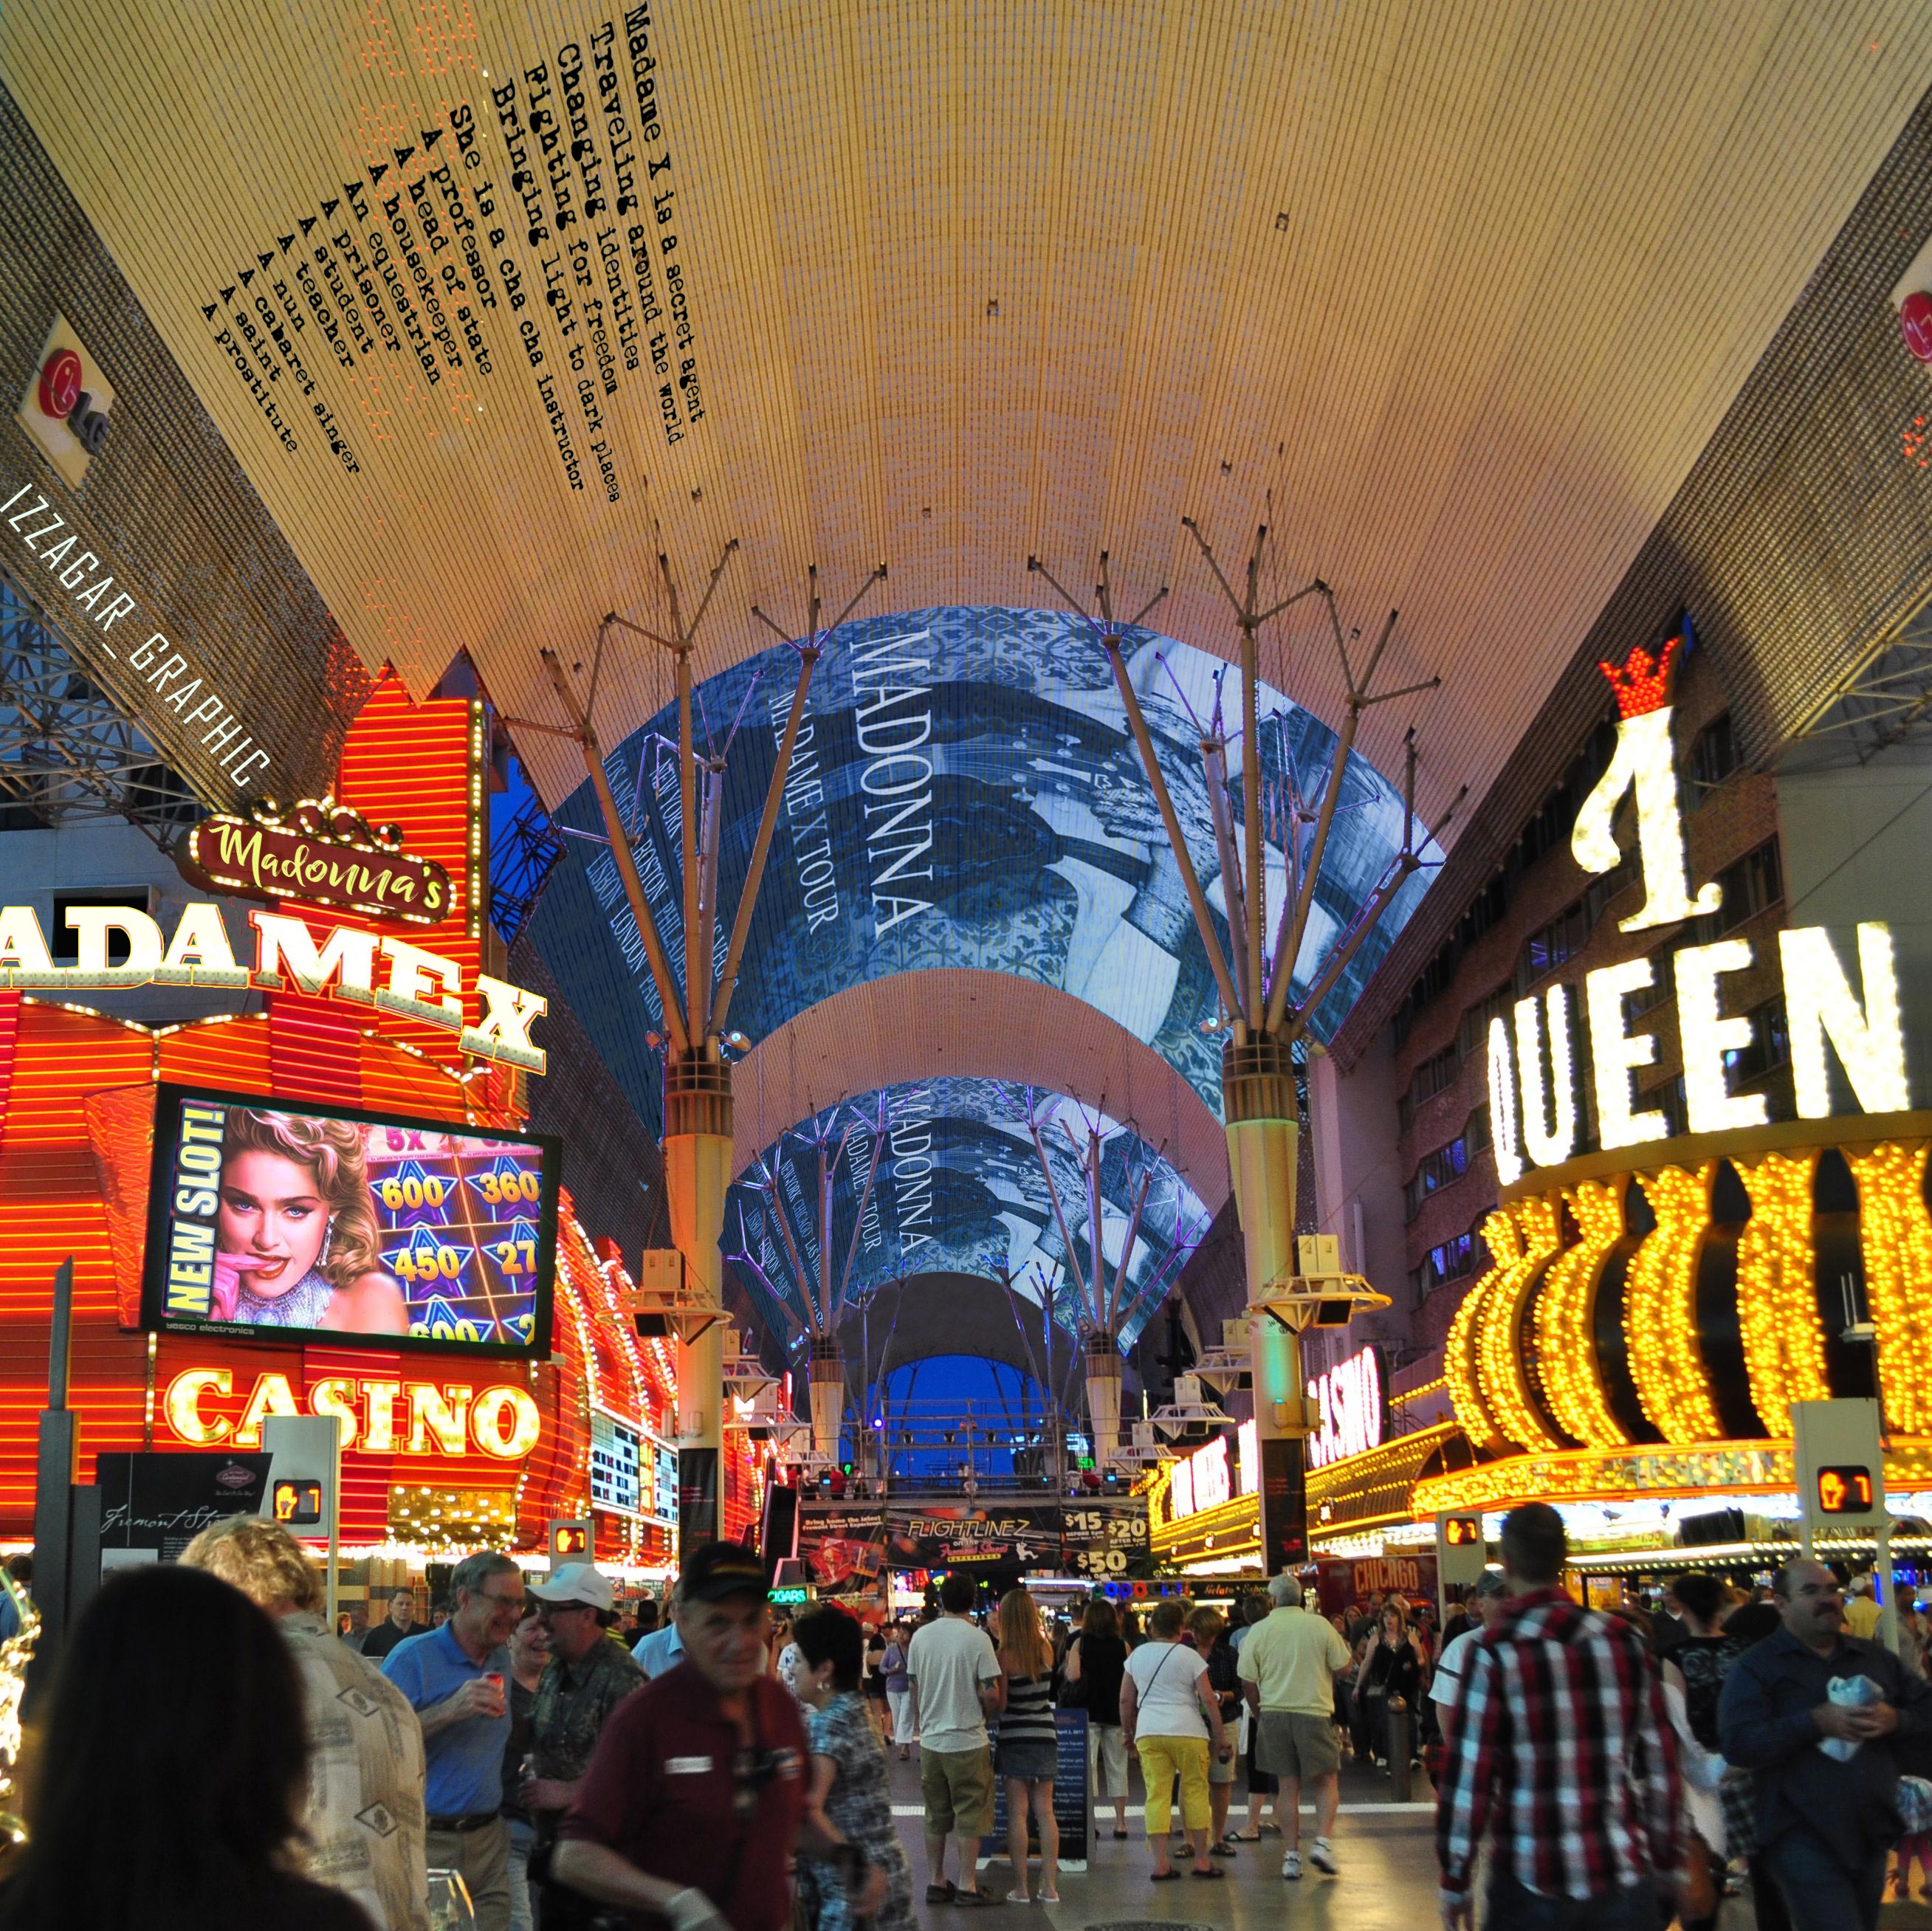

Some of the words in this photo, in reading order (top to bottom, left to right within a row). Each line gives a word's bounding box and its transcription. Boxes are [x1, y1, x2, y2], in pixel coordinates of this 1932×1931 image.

[624, 1, 661, 142] Madame
[420, 128, 443, 152] A
[590, 21, 639, 216] Traveling
[492, 78, 550, 247] Bringing
[648, 151, 671, 181] X
[429, 162, 498, 309] professor
[523, 60, 577, 231] Fighting
[568, 238, 593, 286] for
[583, 297, 618, 396] freedom
[557, 43, 607, 219] Changing
[597, 227, 639, 371] identities
[653, 190, 675, 225] is
[661, 235, 678, 255] a
[257, 251, 275, 272] A
[272, 279, 306, 333] nun
[277, 233, 295, 255] A
[295, 261, 354, 368] teacher
[298, 216, 317, 238] A
[314, 246, 374, 354] student
[320, 199, 340, 221] A
[331, 229, 401, 351] prisoner
[343, 181, 369, 223] An
[368, 232, 441, 386] equestrian
[368, 163, 389, 187] A
[382, 191, 463, 368] housekeeper
[393, 146, 416, 170] A
[408, 174, 450, 256] head
[441, 265, 466, 295] of
[457, 306, 492, 376] state
[449, 104, 481, 170] She
[473, 181, 495, 218] is
[489, 227, 505, 249] a
[499, 259, 526, 311] cha
[520, 320, 543, 368] cha
[537, 374, 584, 490] instructor
[540, 251, 577, 337] light
[628, 224, 663, 325] around
[219, 286, 236, 306] A
[235, 311, 281, 382] saint
[666, 264, 695, 350] secret
[201, 303, 218, 323] A
[214, 327, 298, 452] prostitute
[237, 269, 255, 289] A
[255, 296, 315, 396] cabaret
[313, 402, 360, 473] singer
[568, 343, 585, 371] to
[650, 331, 669, 375] the
[679, 357, 706, 423] agent
[70, 390, 109, 452] LG
[577, 379, 604, 434] dark
[659, 382, 684, 446] world
[590, 439, 620, 503] places
[850, 627, 935, 939] MADONNA
[210, 822, 443, 909] Madonna's
[791, 810, 828, 845] X
[632, 836, 669, 905] BOSTON
[797, 838, 840, 936] TOUR
[585, 849, 625, 912] LISBON
[610, 902, 649, 976] LONDON
[1487, 920, 1911, 1187] QUEEN
[175, 1106, 226, 1216] SLOT!
[382, 1174, 444, 1211] 600
[479, 1170, 540, 1205] 360
[785, 1174, 802, 1203] YORK
[886, 1088, 933, 1257] MADONNA
[792, 1198, 812, 1239] CHICAGO
[862, 1202, 882, 1255] TOUR
[168, 1222, 216, 1315] NEW
[393, 1245, 460, 1282] 450
[199, 1324, 255, 1335] electronics
[164, 1367, 541, 1461] CASINO
[100, 1504, 188, 1534] Fremont
[907, 1518, 1045, 1539] FLIGHTLINEZ
[1065, 1512, 1102, 1530] $15
[1108, 1518, 1147, 1538] $20
[767, 1589, 807, 1603] CIGARS
[1077, 1550, 1127, 1573] $50
[1204, 1583, 1234, 1595] Gelato
[1354, 1559, 1419, 1594] CHICAGO
